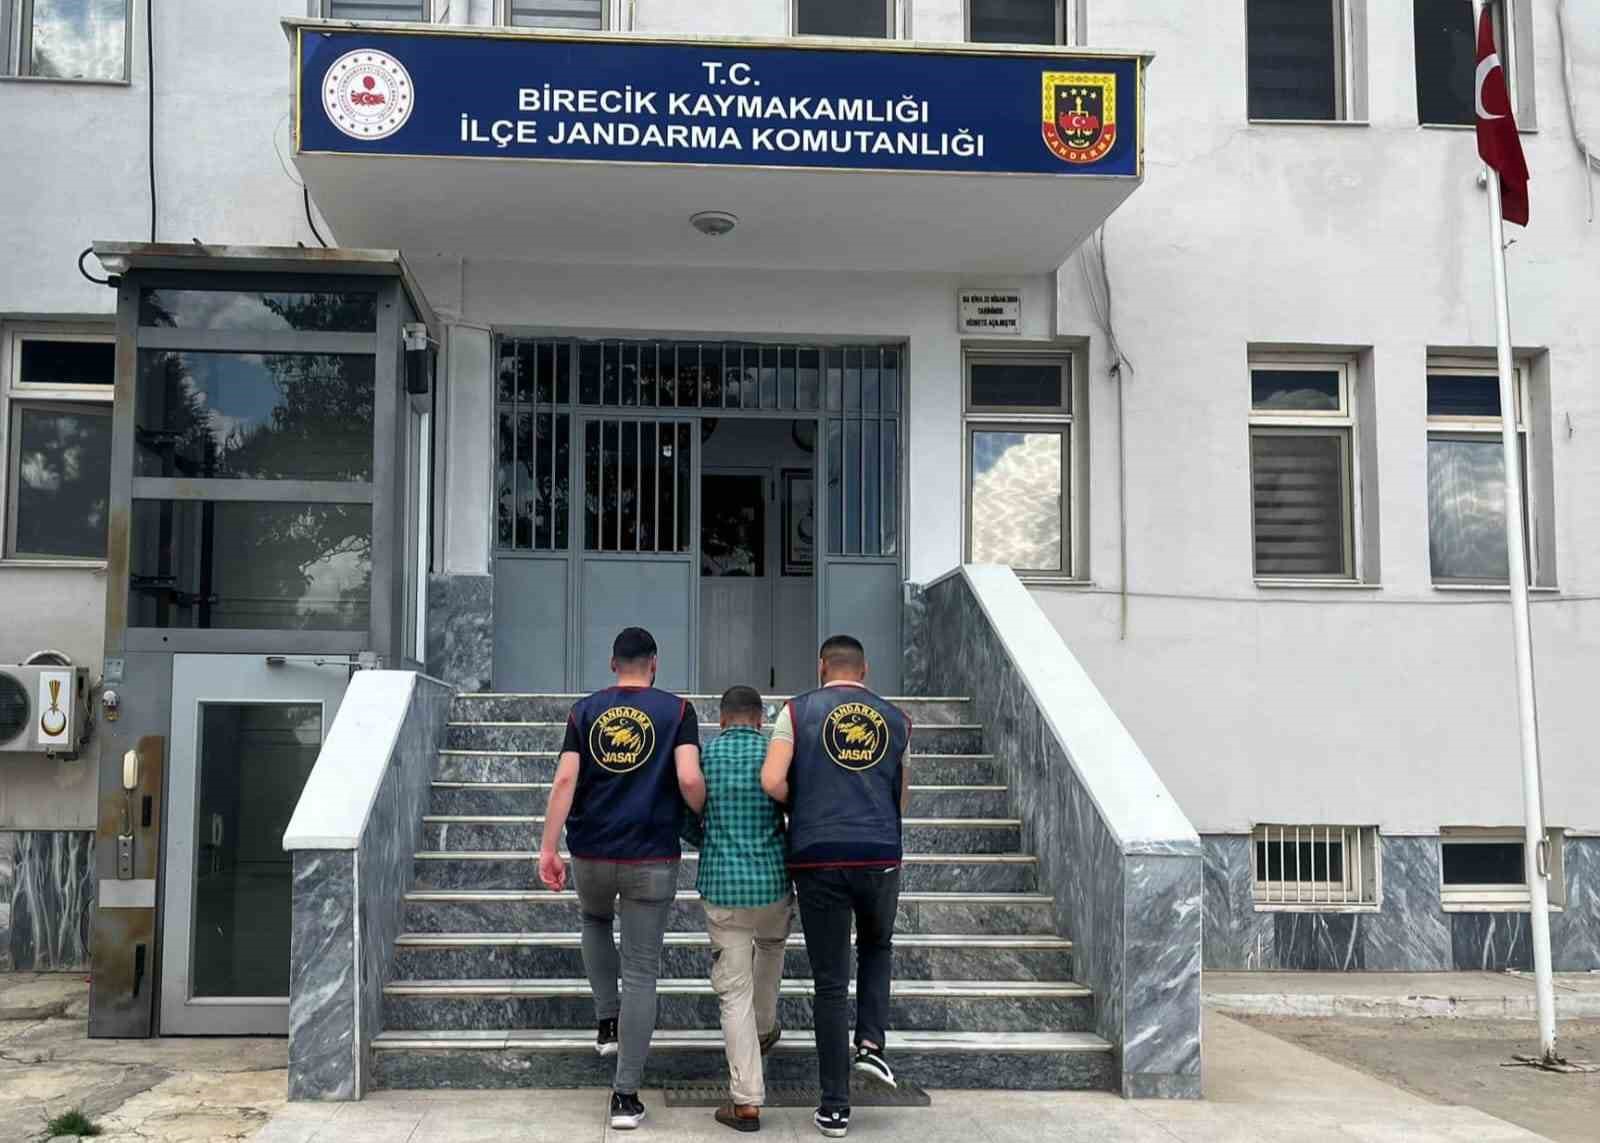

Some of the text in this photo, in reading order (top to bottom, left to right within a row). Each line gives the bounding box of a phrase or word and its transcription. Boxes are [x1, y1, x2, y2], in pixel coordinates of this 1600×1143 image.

[701, 61, 761, 87] T.C.
[518, 83, 930, 123] BİRECİK KAYMAKAMLIĞI
[460, 112, 985, 157] İLÇE JANDARMA KOMUTANLIĞI
[1046, 131, 1112, 161] JANDARMA
[598, 707, 650, 730] JANDARMA
[829, 704, 883, 727] JANDARMA
[602, 751, 639, 764] JASAT
[837, 748, 873, 761] JASAT
